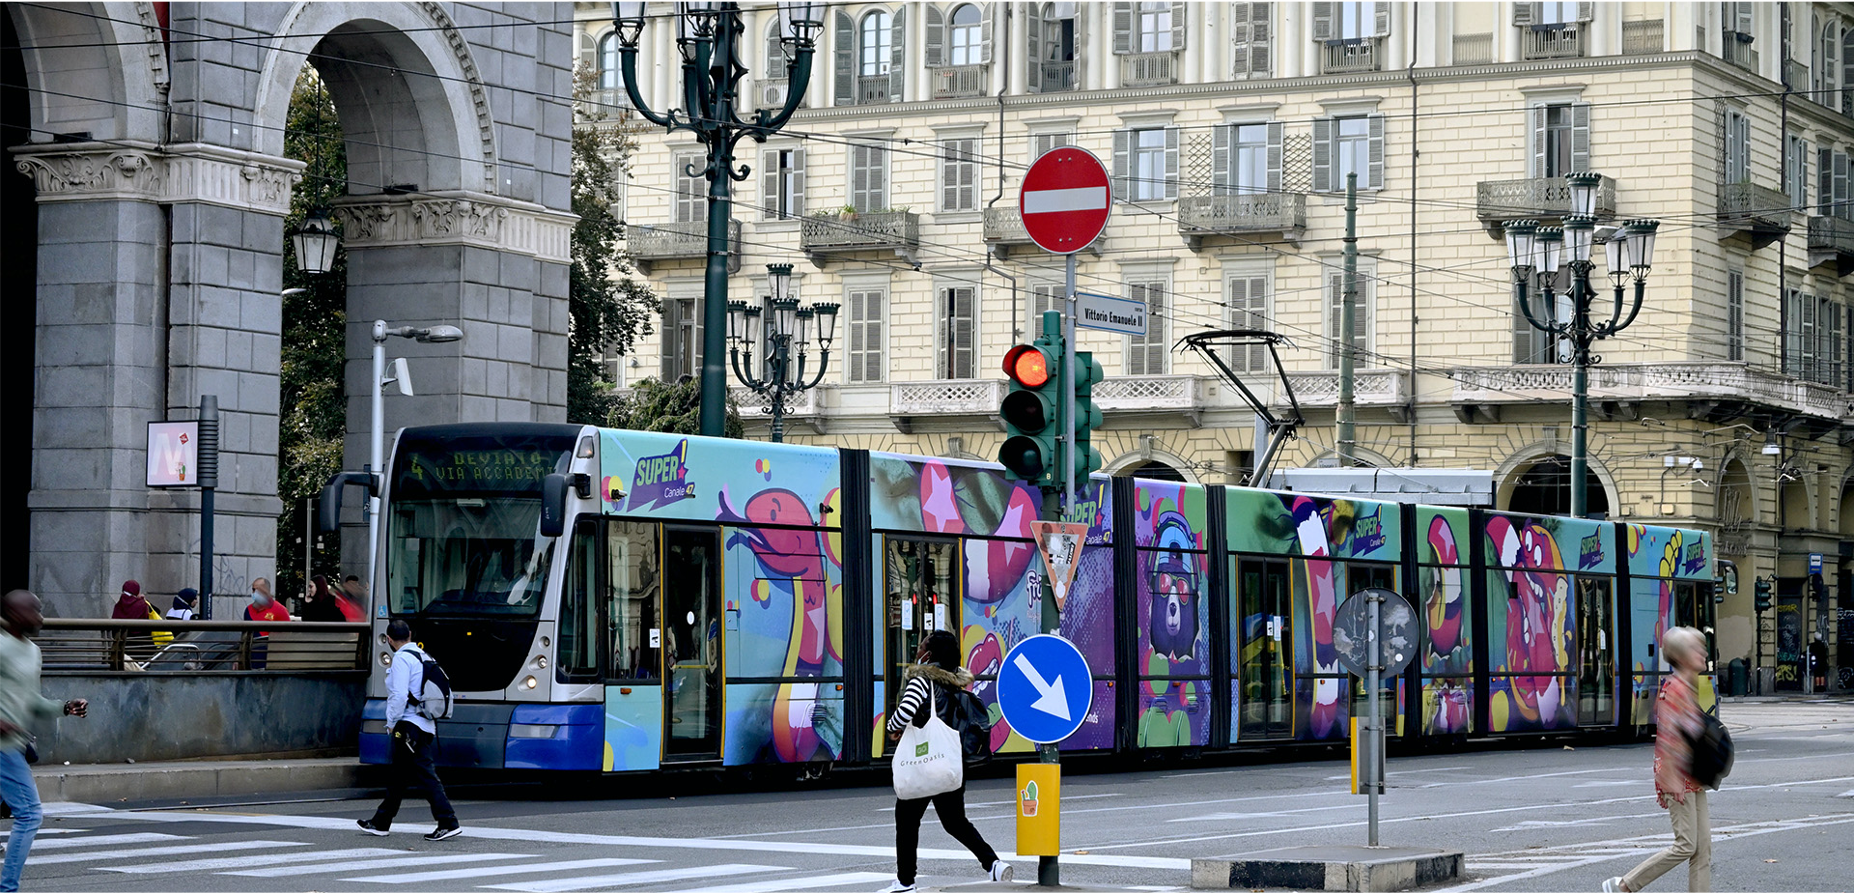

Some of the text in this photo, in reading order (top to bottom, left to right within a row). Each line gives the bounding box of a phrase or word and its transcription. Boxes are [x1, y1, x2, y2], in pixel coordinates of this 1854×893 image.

[1084, 308, 1107, 322] Vittorio
[1109, 312, 1137, 326] Emanuele
[151, 433, 194, 476] M
[454, 452, 541, 465] DEVIATO
[411, 453, 423, 480] 4
[436, 467, 465, 480] VIA
[664, 486, 685, 498] Canale
